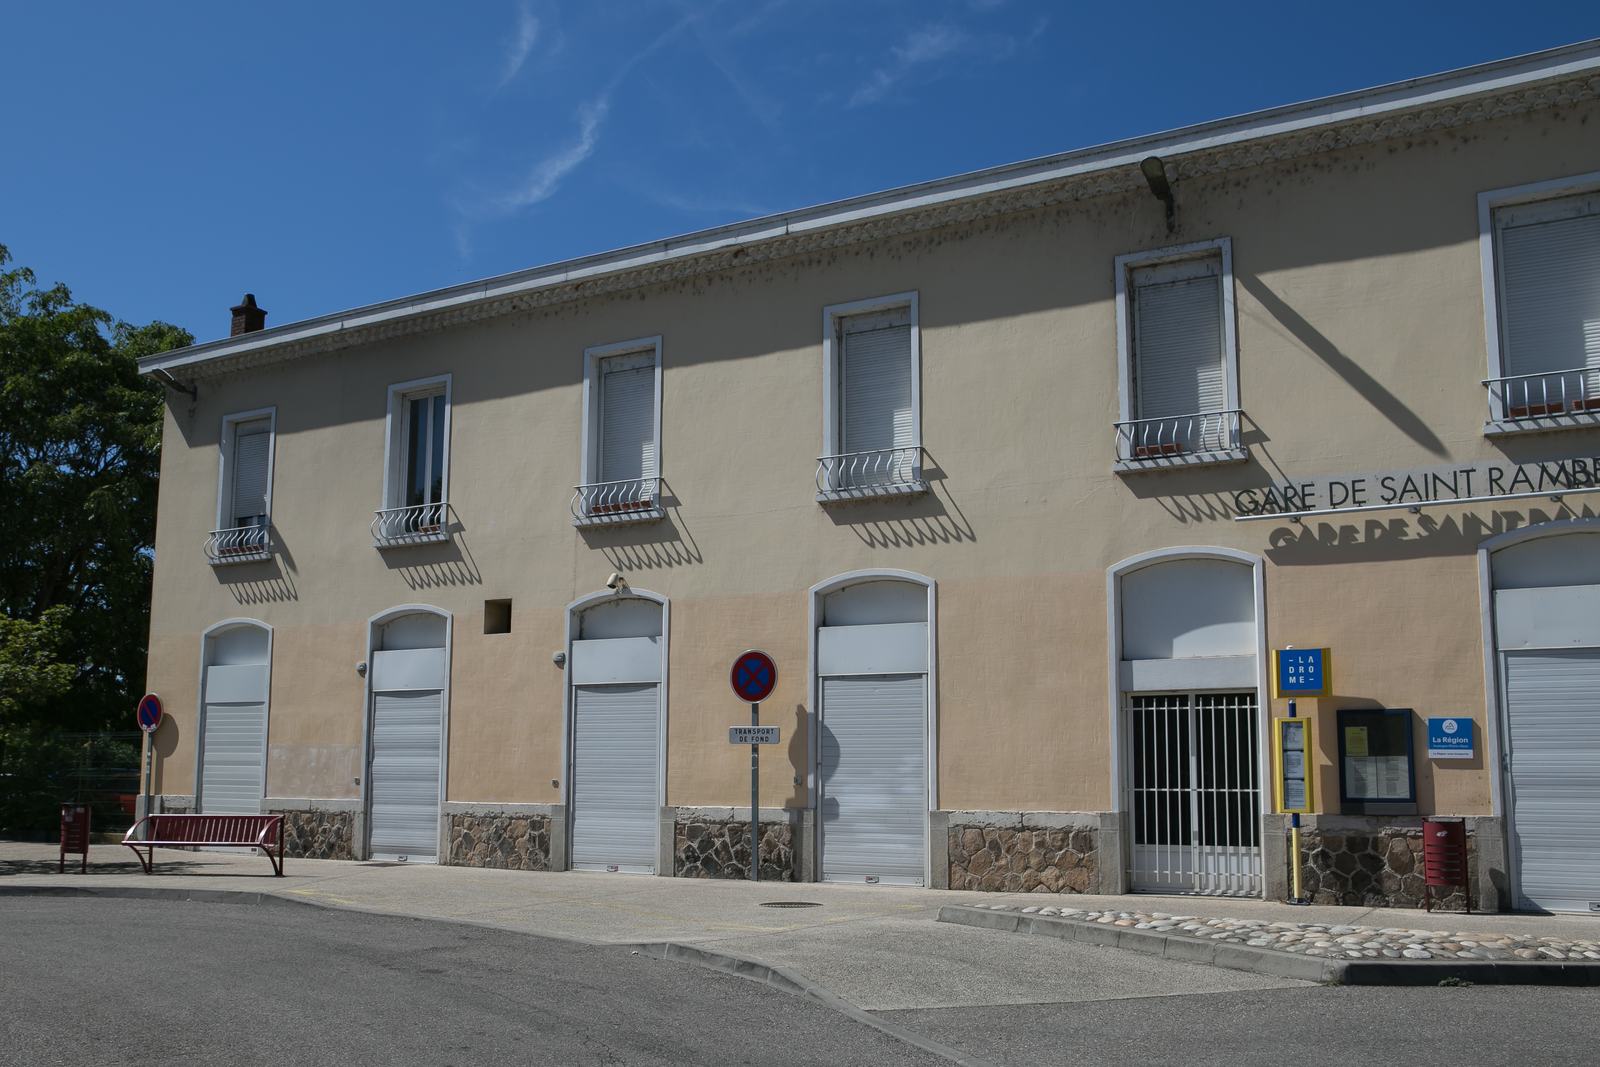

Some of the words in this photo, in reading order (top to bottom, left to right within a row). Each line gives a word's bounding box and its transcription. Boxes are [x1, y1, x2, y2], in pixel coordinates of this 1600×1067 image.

[1235, 482, 1316, 514] GARE
[1329, 479, 1366, 506] DE
[1380, 467, 1476, 502] SAINT
[1442, 736, 1469, 744] Région
